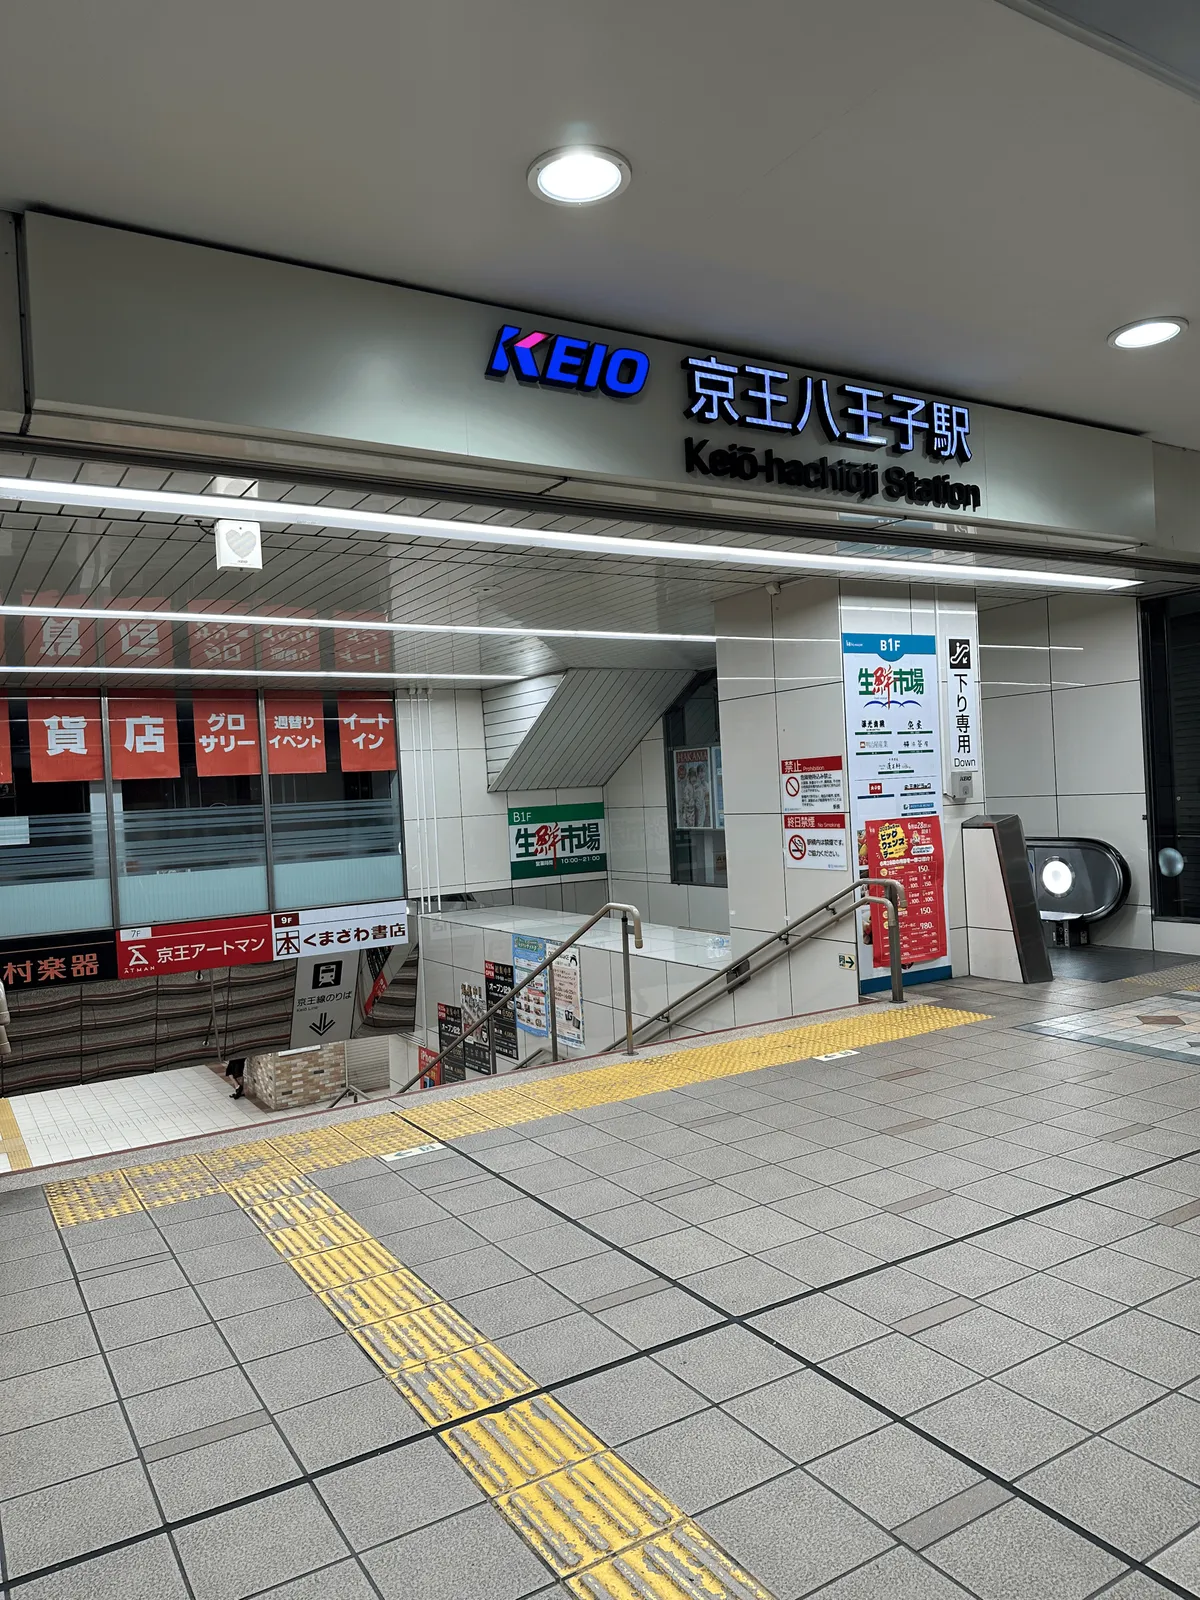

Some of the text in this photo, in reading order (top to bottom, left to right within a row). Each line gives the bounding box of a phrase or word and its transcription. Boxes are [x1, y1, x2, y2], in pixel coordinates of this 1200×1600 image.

[487, 324, 651, 396] KEIO
[685, 356, 973, 463] 京王八王子駅
[884, 466, 981, 512] Station
[880, 638, 901, 652] B1F
[858, 664, 925, 710] 生鮮市場
[206, 713, 245, 732] グロ
[273, 715, 315, 730] 週替り
[343, 713, 390, 730] イート
[953, 673, 971, 754] 下り専用
[44, 714, 88, 756] 貨
[123, 715, 166, 753] 店
[268, 733, 322, 749] イベント
[352, 732, 384, 750] イン
[199, 735, 256, 753] サリー
[784, 760, 802, 773] 禁止
[954, 757, 976, 768] Down
[513, 812, 532, 823] B1F
[515, 821, 601, 870] 生鮮市場
[281, 916, 292, 925] 9F
[131, 929, 141, 938] 7F
[303, 923, 406, 948] くまざわ書店
[156, 937, 266, 965] 京王アートマン
[296, 991, 353, 1007] 京王線のりば
